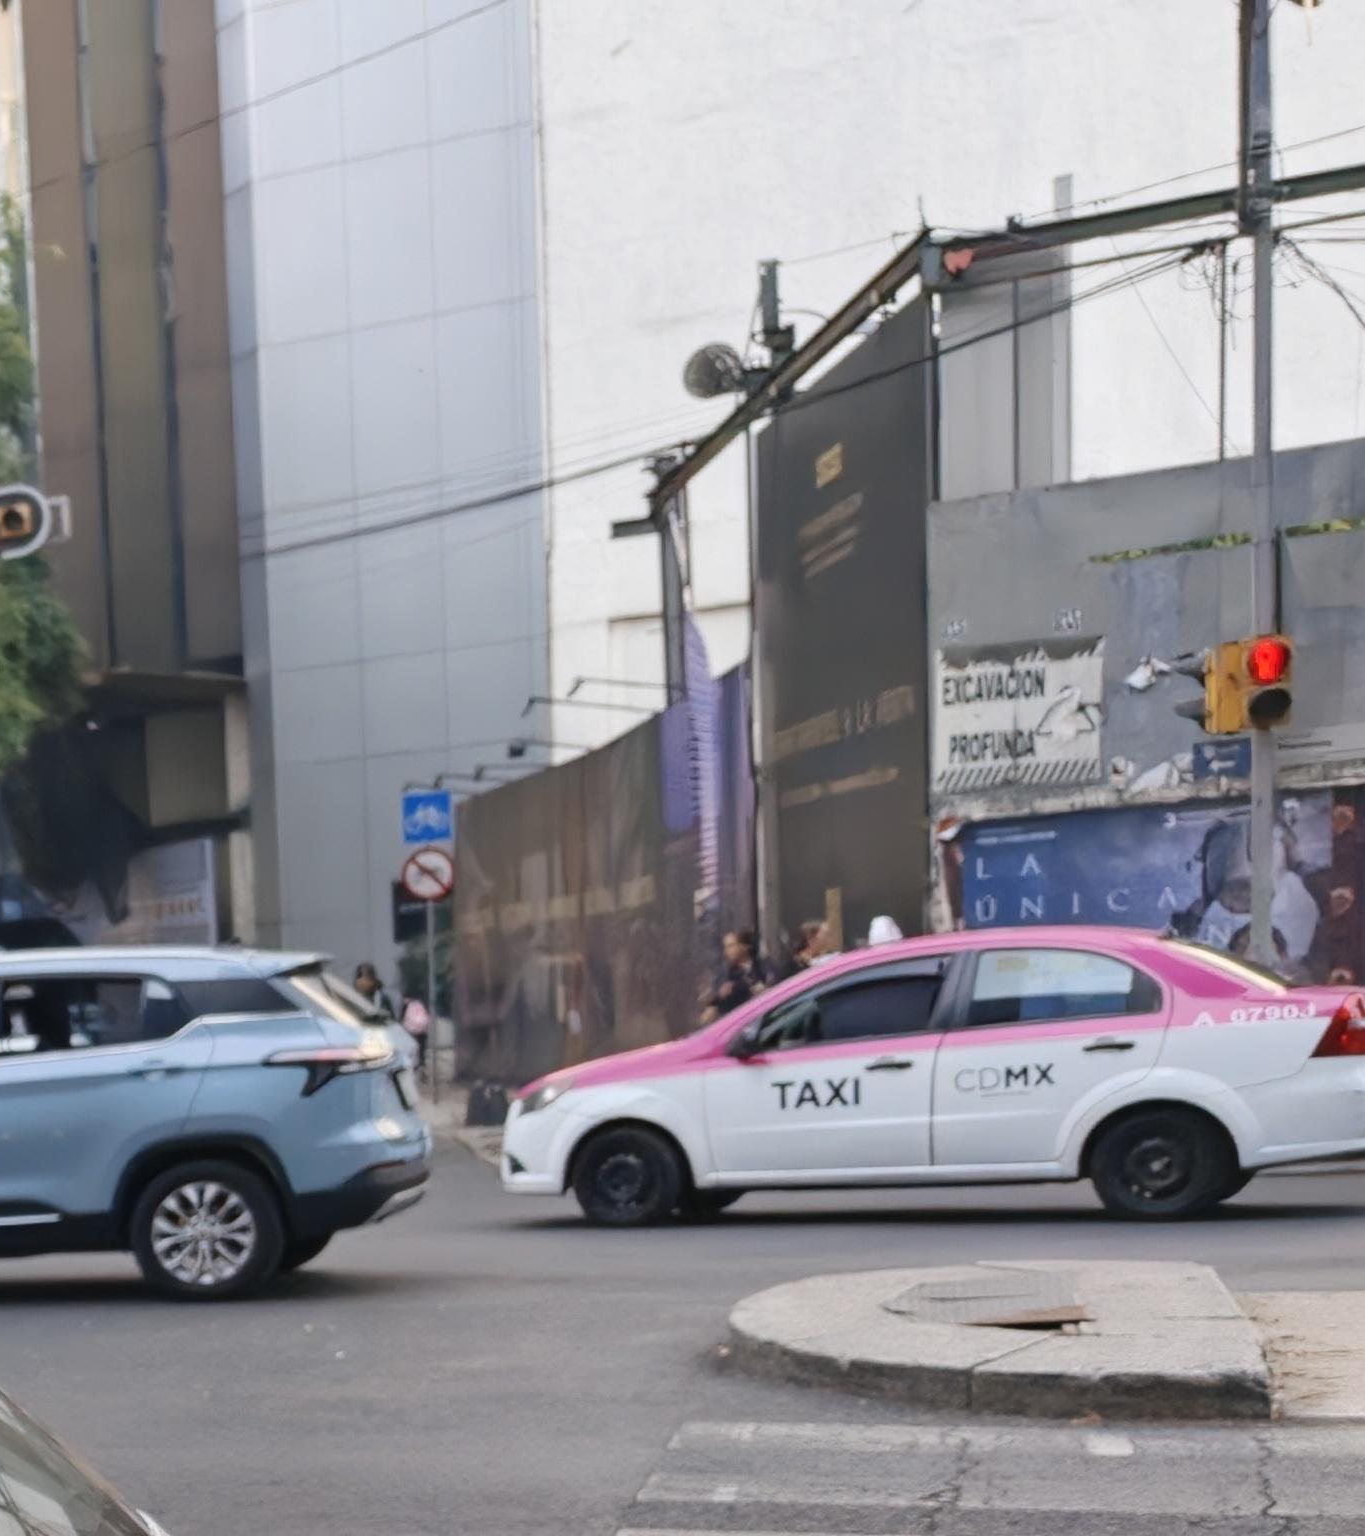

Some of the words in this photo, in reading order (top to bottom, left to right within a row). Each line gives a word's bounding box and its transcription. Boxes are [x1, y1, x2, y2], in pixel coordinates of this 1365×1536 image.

[949, 729, 1036, 763] PROFUNDA
[975, 853, 1043, 880] LA
[955, 1062, 1055, 1092] CDMX
[771, 1077, 860, 1110] TAXI
